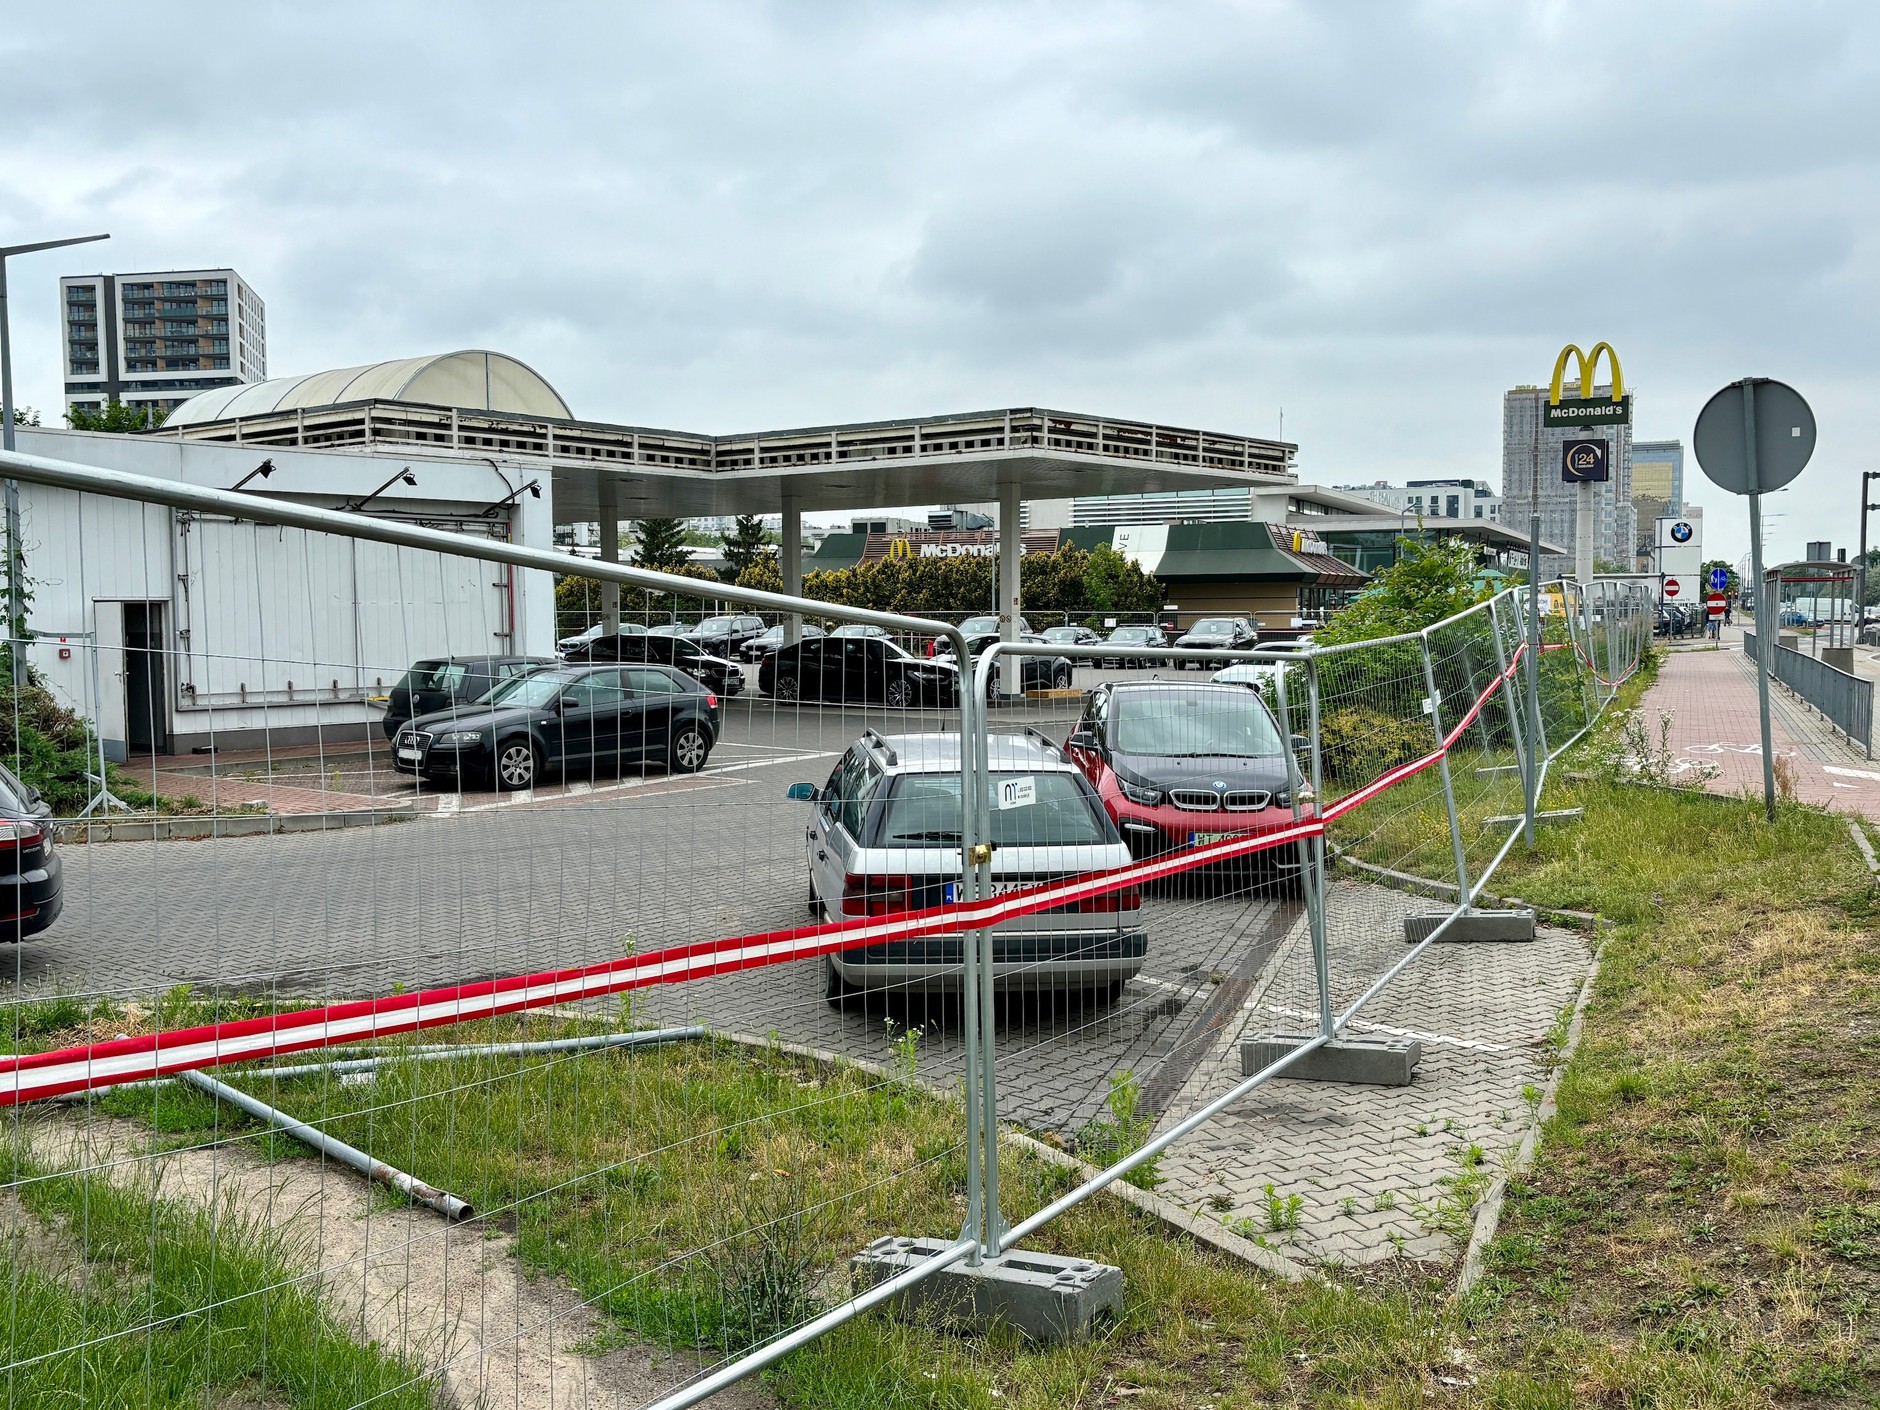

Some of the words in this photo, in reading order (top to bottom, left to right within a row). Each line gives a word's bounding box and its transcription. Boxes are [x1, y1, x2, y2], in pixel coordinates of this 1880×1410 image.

[1550, 405, 1623, 418] McDonald's
[1578, 453, 1595, 465] 24
[920, 543, 1027, 558] McDonals
